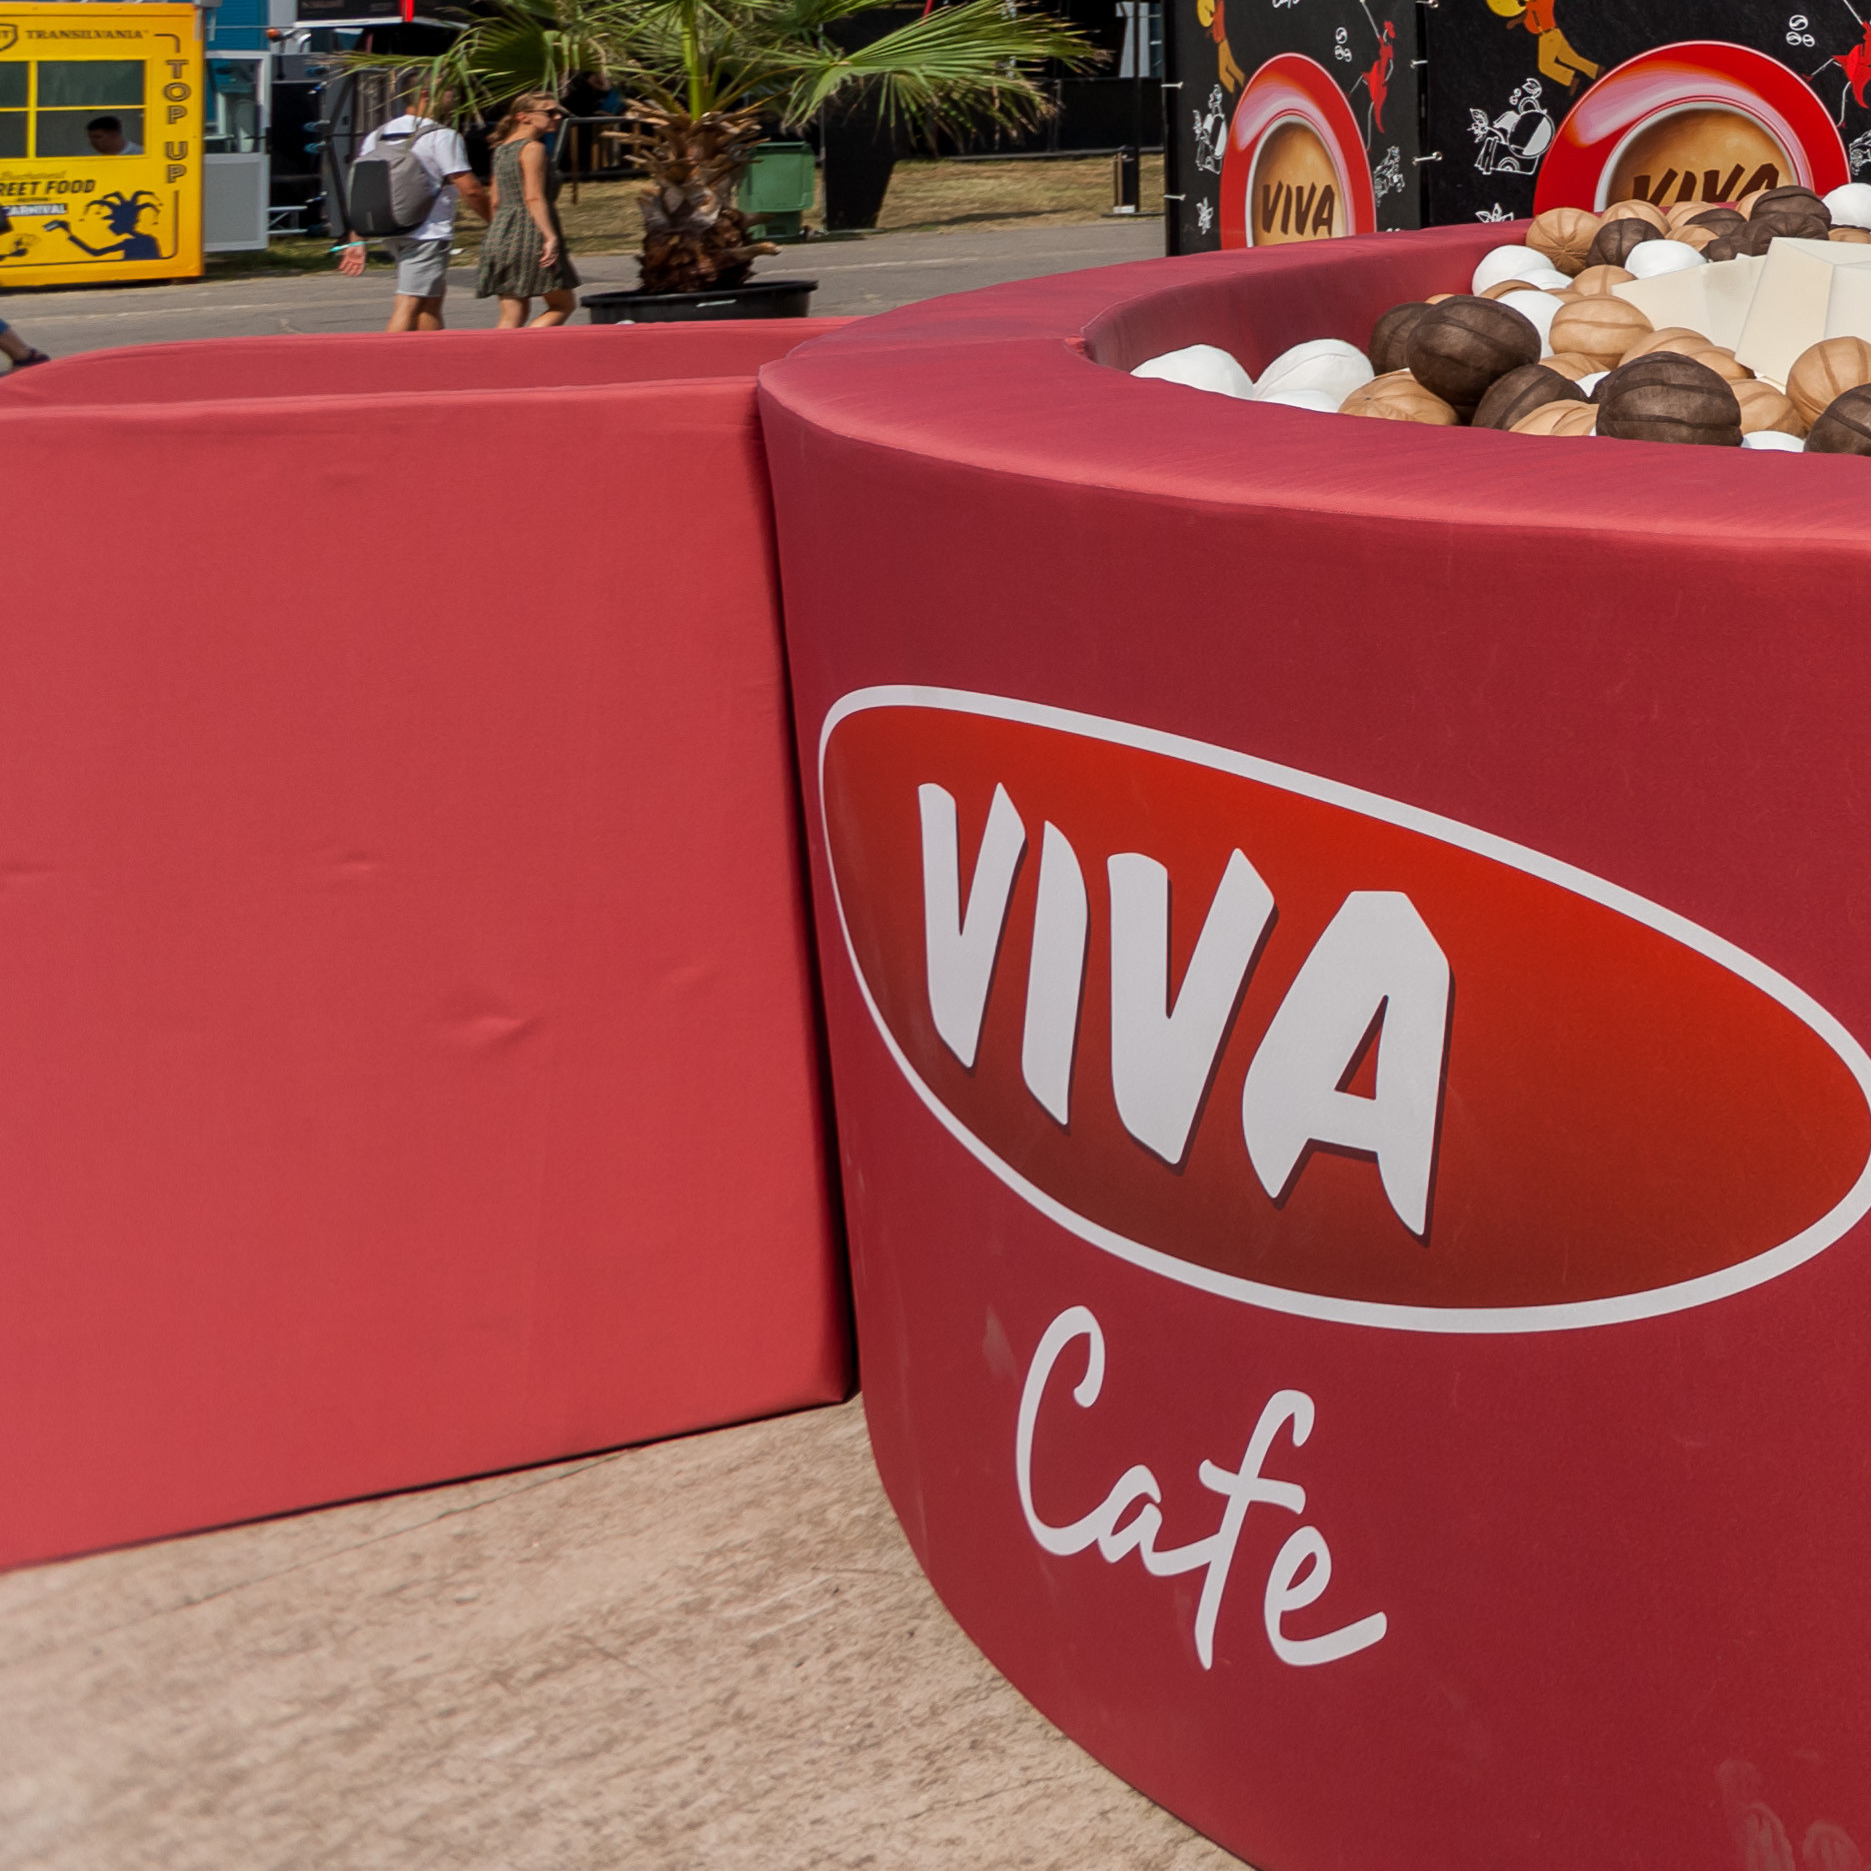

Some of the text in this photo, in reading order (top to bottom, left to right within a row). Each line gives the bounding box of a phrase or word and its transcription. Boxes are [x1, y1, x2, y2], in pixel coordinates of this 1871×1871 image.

[26, 29, 144, 39] TRANSILVANIA
[163, 59, 192, 184] TOP UP
[45, 178, 96, 195] FOOD
[4, 204, 66, 217] ARNIVAL
[1262, 180, 1335, 238] VIVA
[918, 782, 1452, 1237] VIVA
